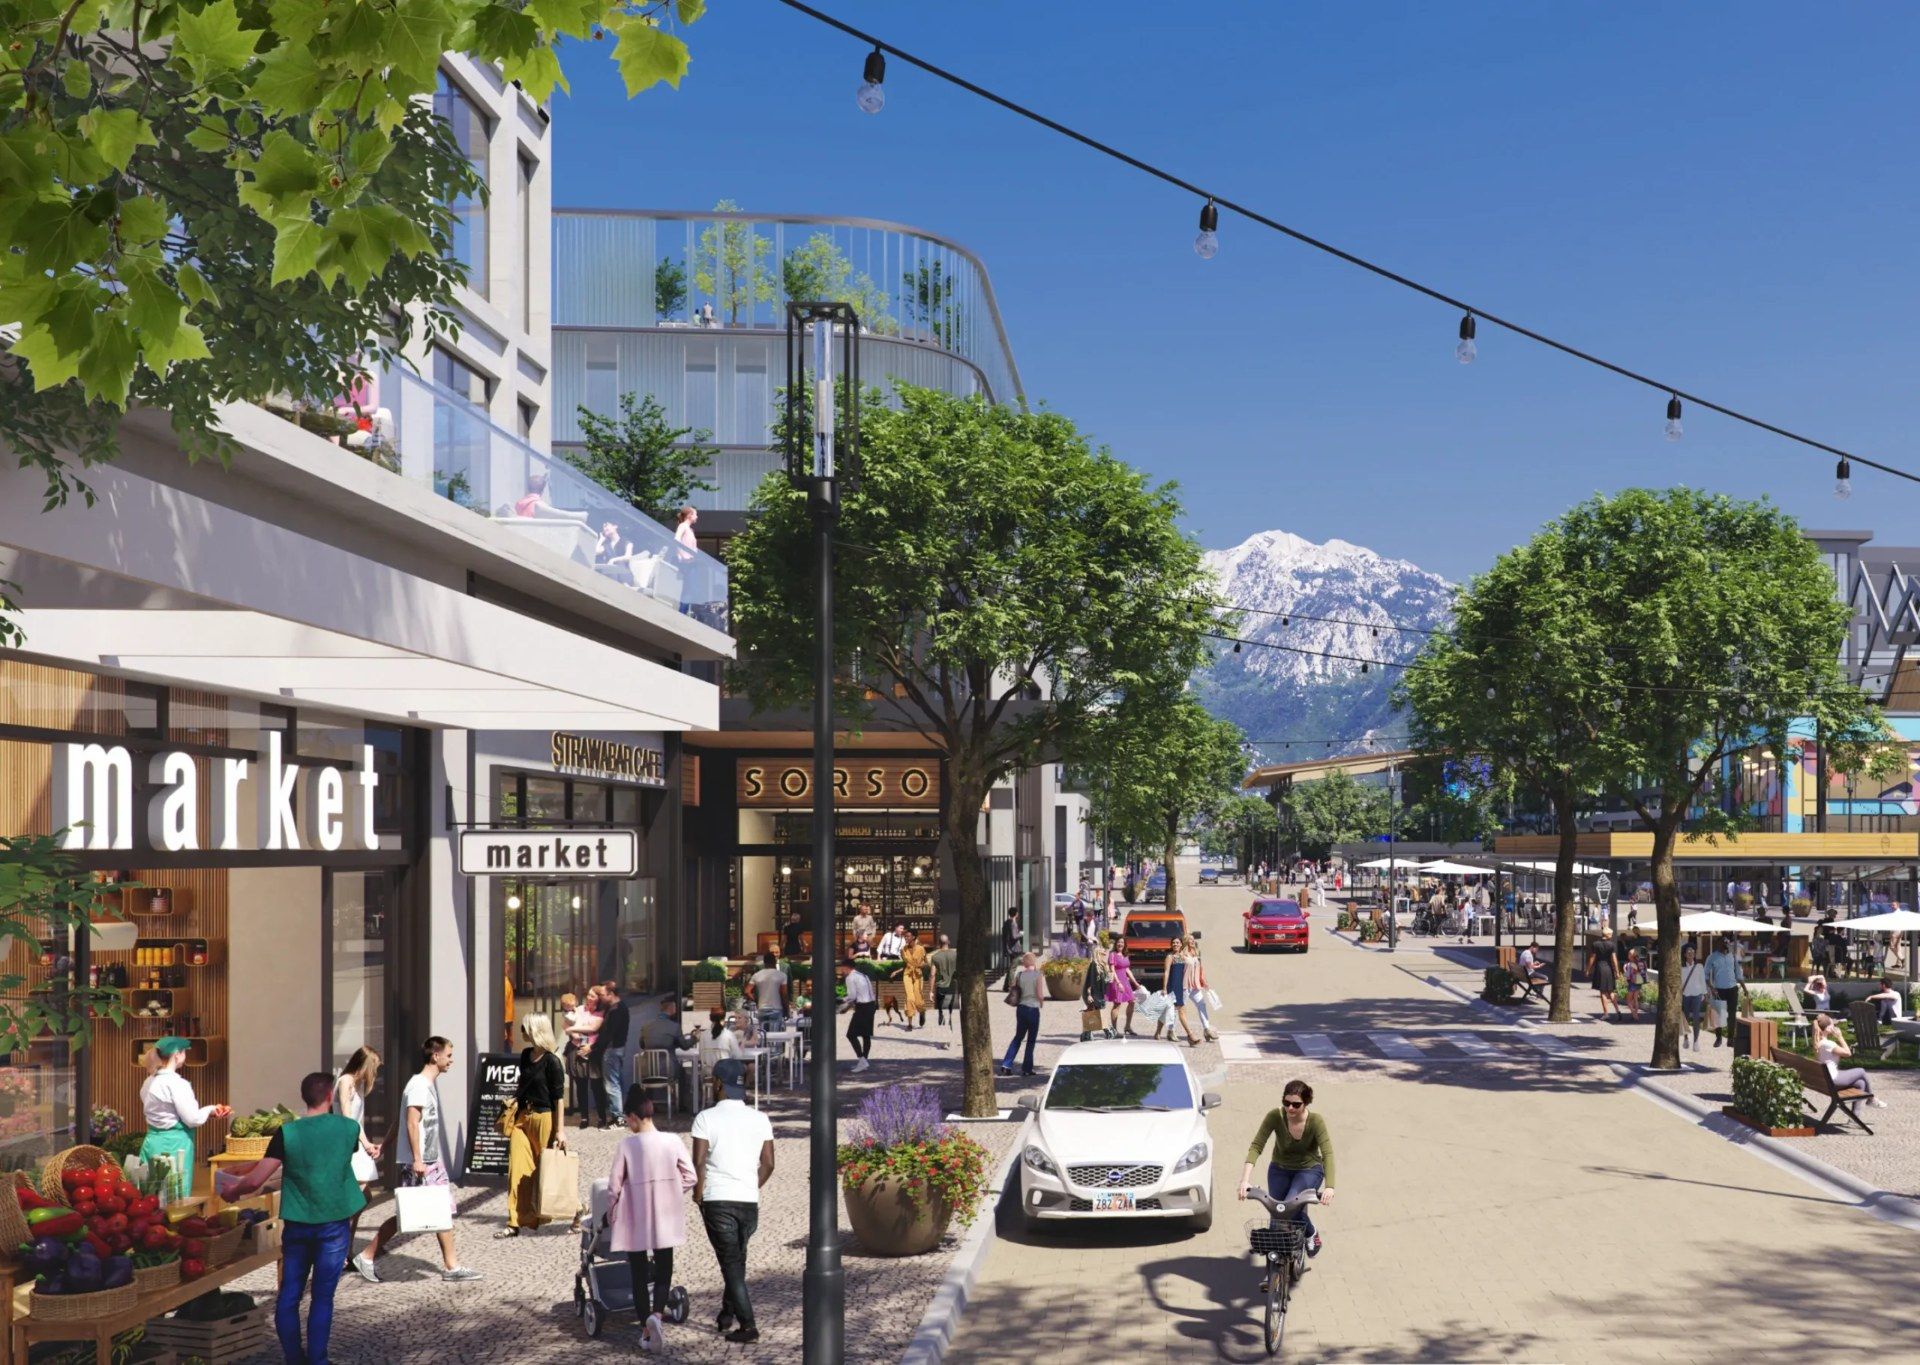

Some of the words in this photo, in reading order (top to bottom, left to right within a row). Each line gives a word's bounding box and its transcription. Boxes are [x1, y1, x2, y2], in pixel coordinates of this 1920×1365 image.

[632, 745, 663, 780] CAFE
[64, 730, 380, 852] market
[744, 766, 929, 798] SORSO
[486, 836, 609, 870] market
